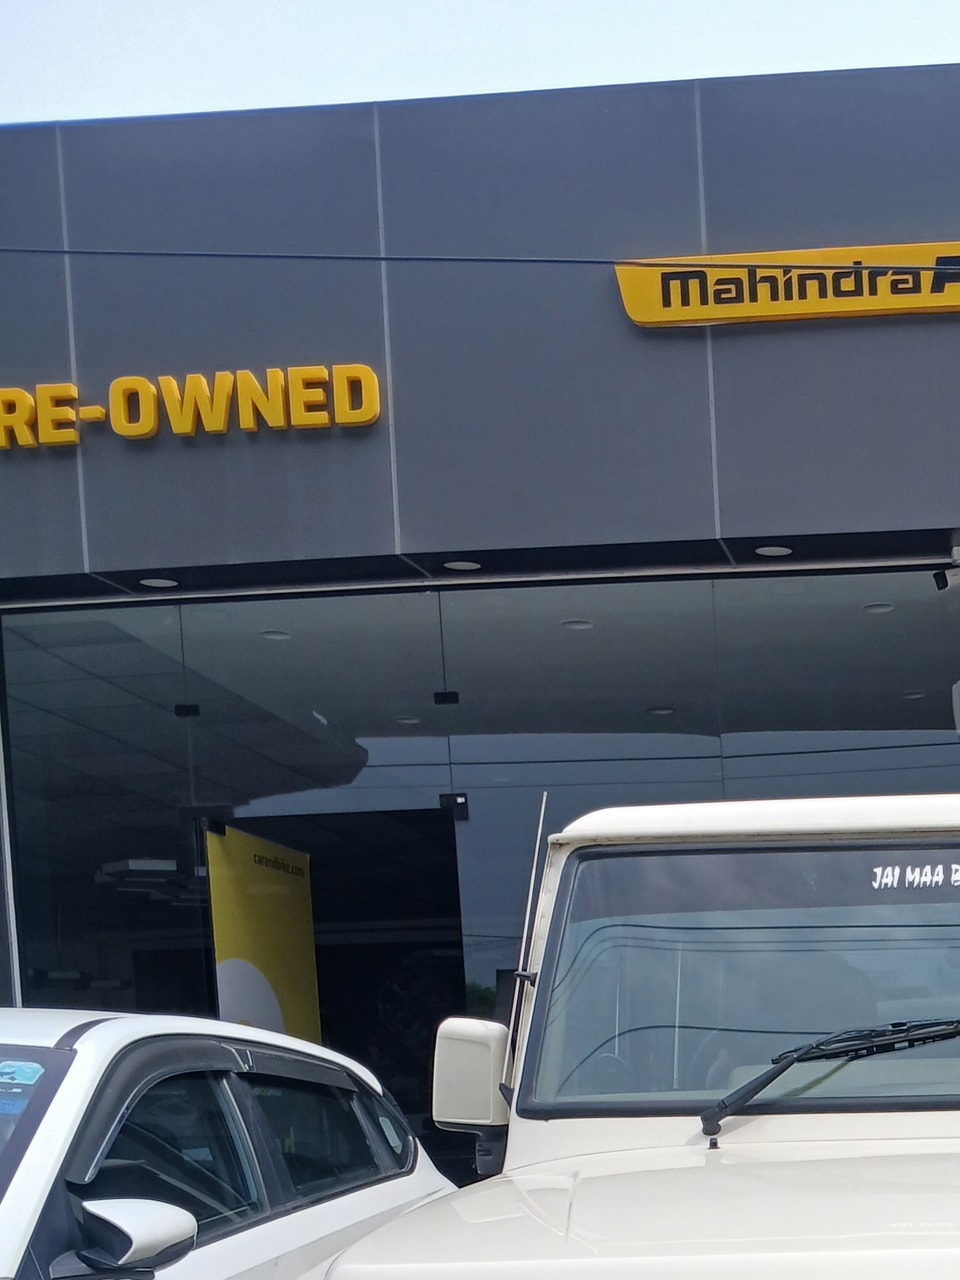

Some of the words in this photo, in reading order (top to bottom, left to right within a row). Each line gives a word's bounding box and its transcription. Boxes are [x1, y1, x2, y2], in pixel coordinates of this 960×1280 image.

[661, 260, 922, 308] Mahindra
[872, 866, 900, 889] JAI
[905, 864, 944, 888] MAA
